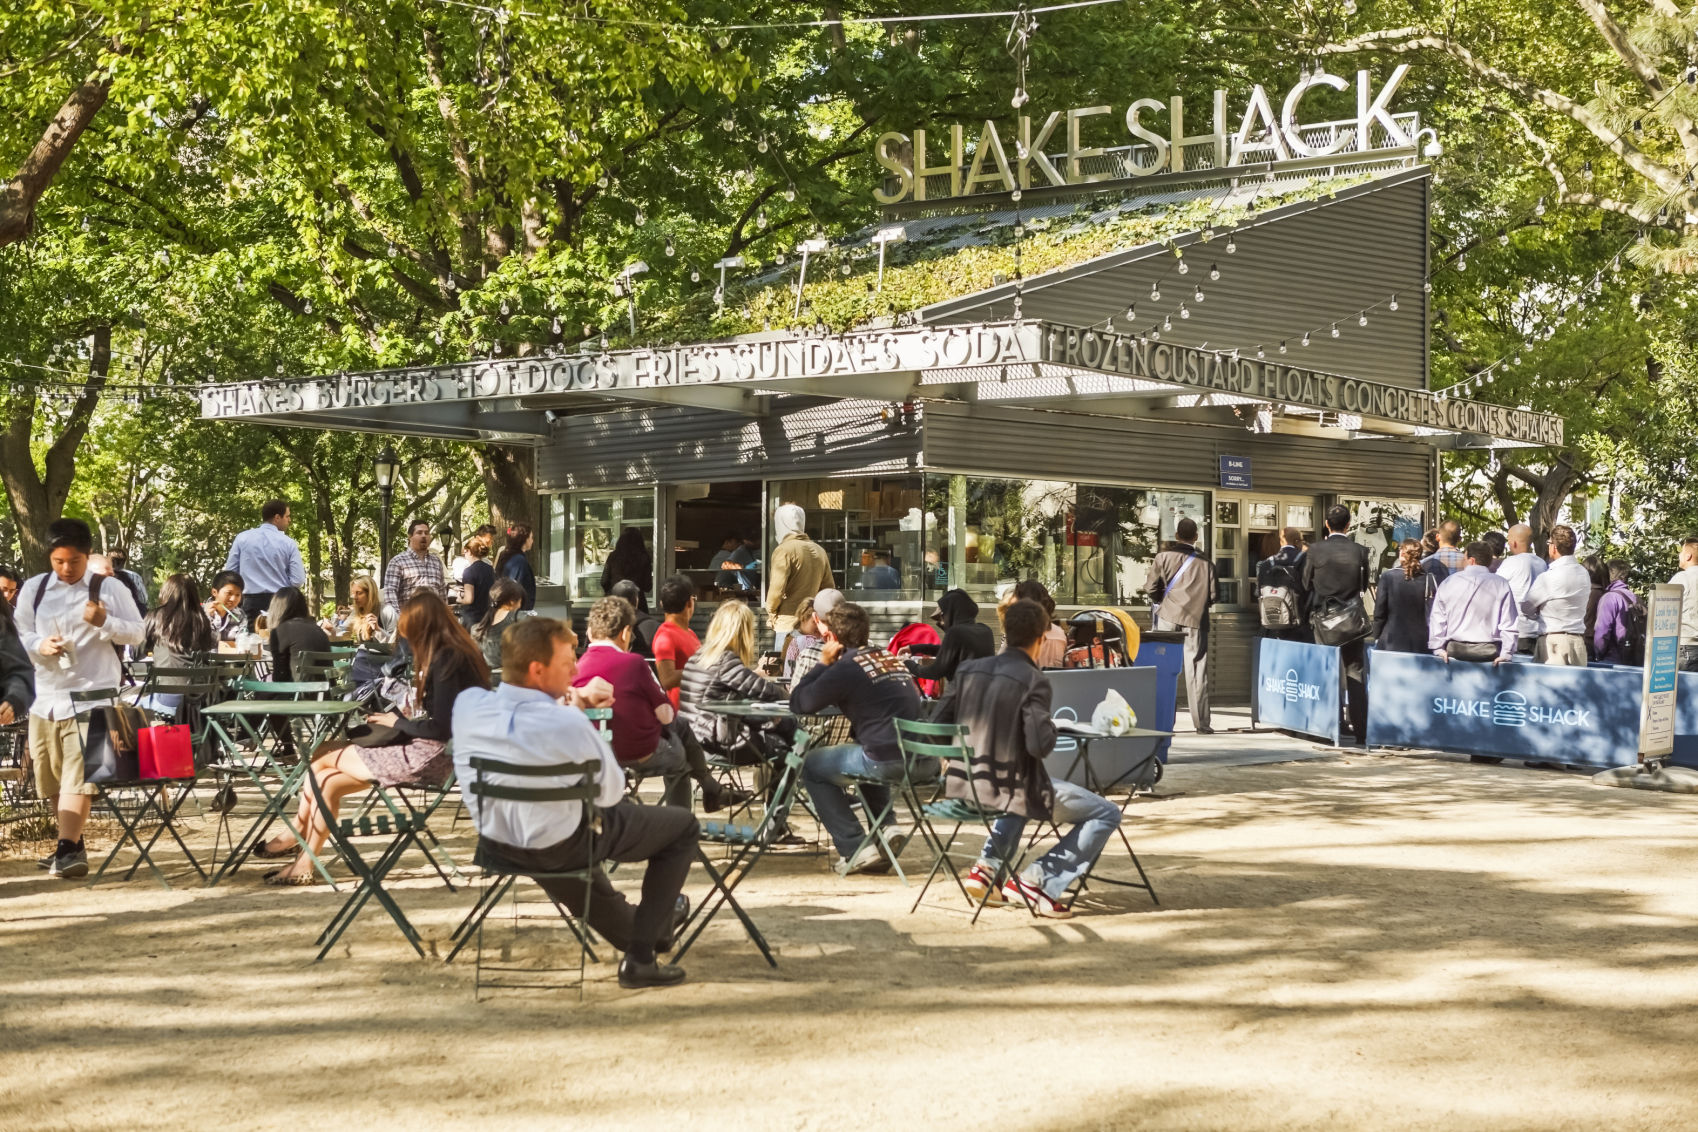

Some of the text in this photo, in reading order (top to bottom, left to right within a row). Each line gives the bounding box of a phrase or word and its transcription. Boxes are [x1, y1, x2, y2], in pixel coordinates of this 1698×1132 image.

[872, 64, 1417, 204] SHAKE SHACK
[202, 382, 304, 417] SHAKES
[315, 371, 441, 409] BURGERS
[632, 347, 719, 386] FRIES
[735, 334, 900, 380] SUNDAES
[921, 326, 1027, 368] SODA
[1048, 324, 1563, 446] FROZEN CUSTARD FLOATS CONCRETES CONES SHAKES
[1265, 677, 1320, 701] SHAKE SHACK
[1433, 697, 1591, 727] SHAKE SHACK
